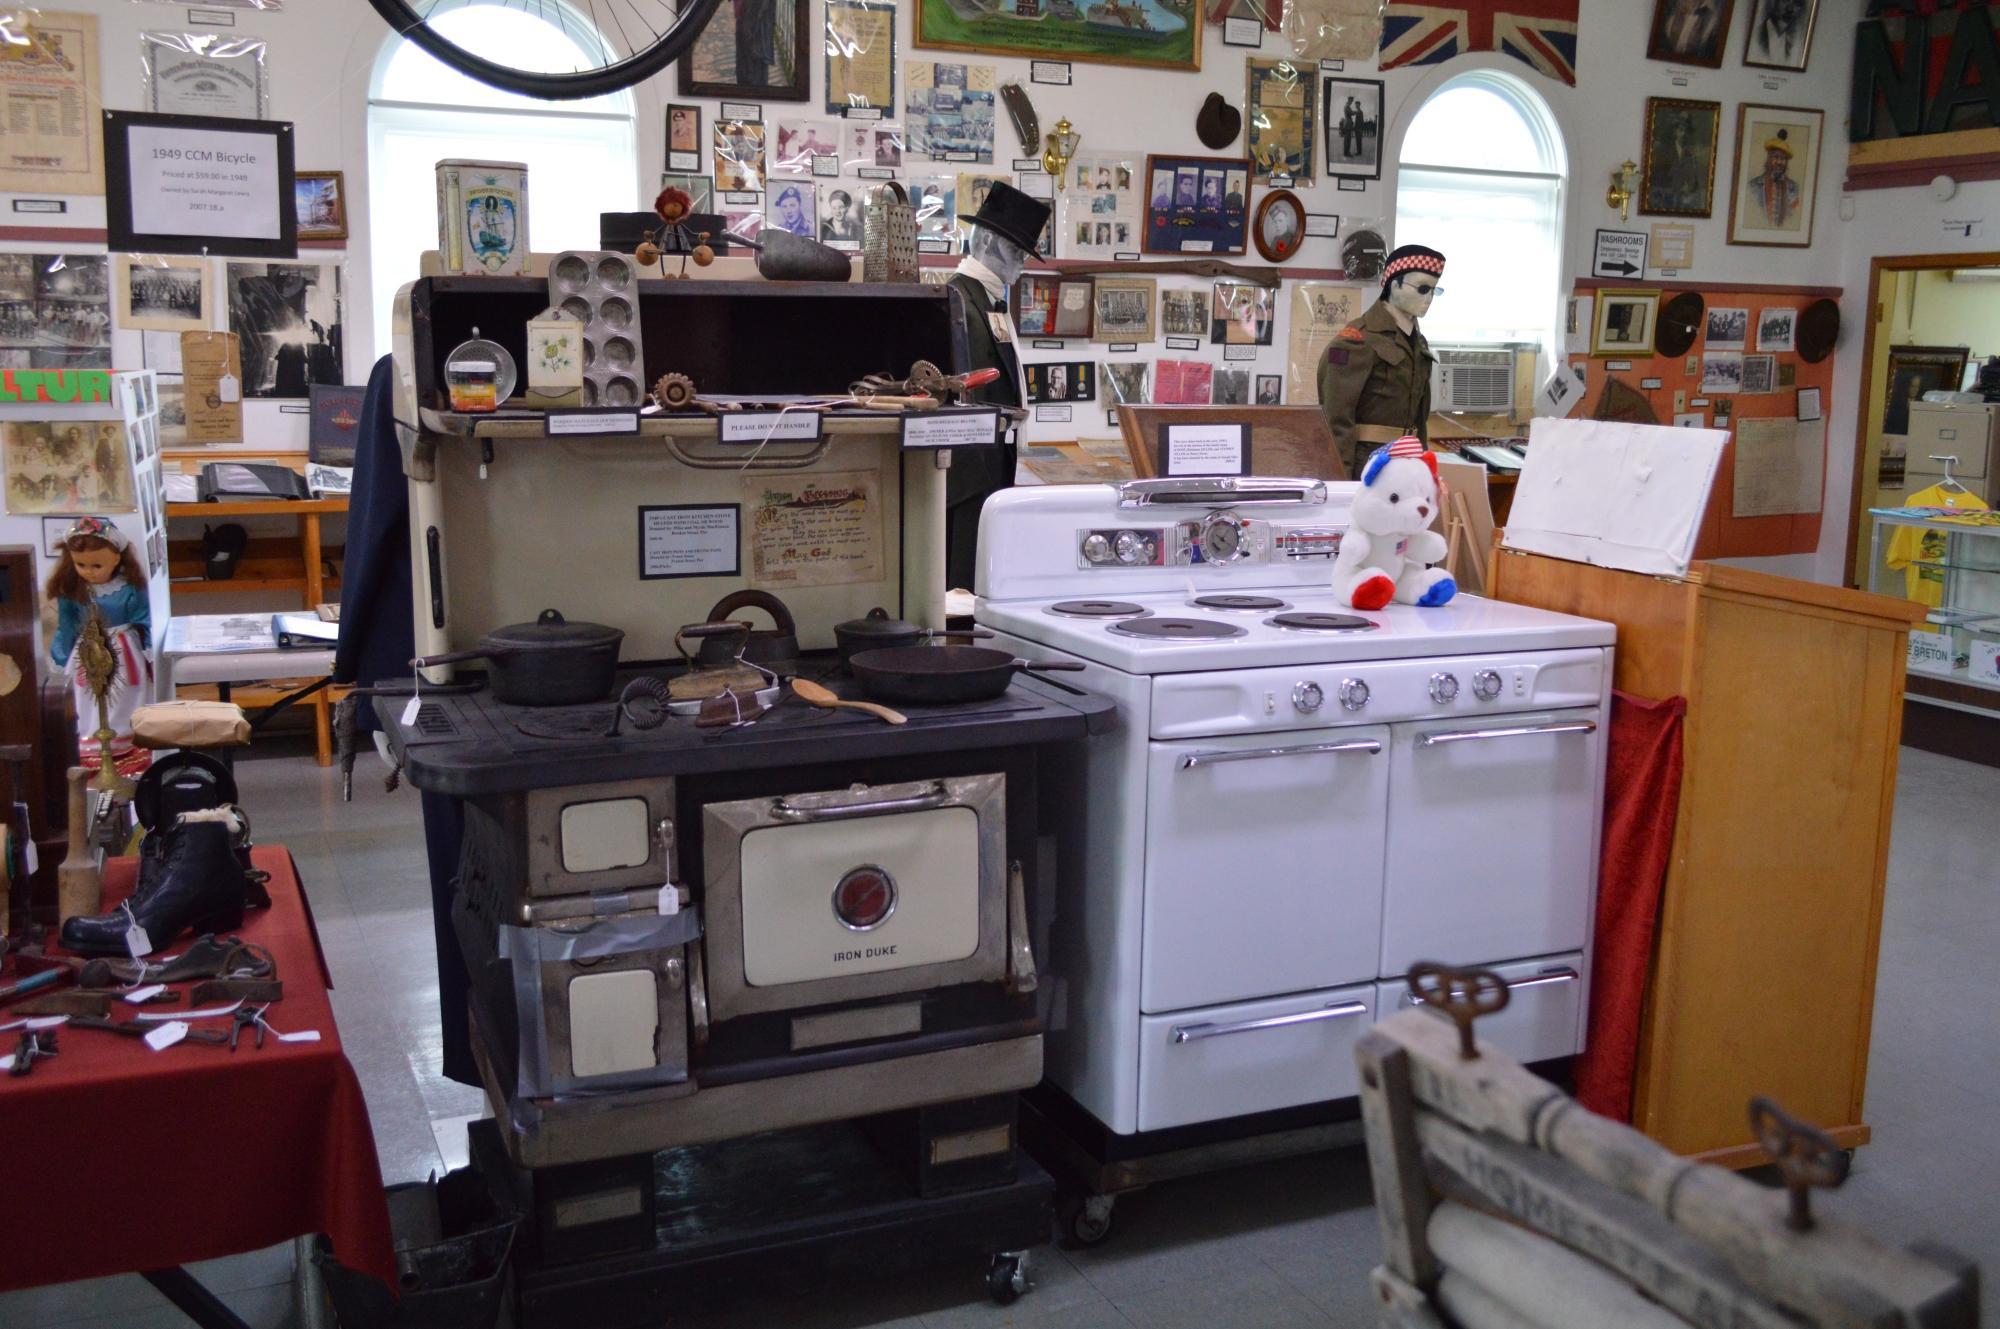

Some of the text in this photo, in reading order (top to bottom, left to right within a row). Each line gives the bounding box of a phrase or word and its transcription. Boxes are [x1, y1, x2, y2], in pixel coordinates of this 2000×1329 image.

[152, 148, 257, 165] 1949 CCM Bicycle
[1600, 235, 1644, 247] WASHROOMS
[1913, 645, 1948, 661] BRETON
[834, 945, 897, 962] IRON DUKE
